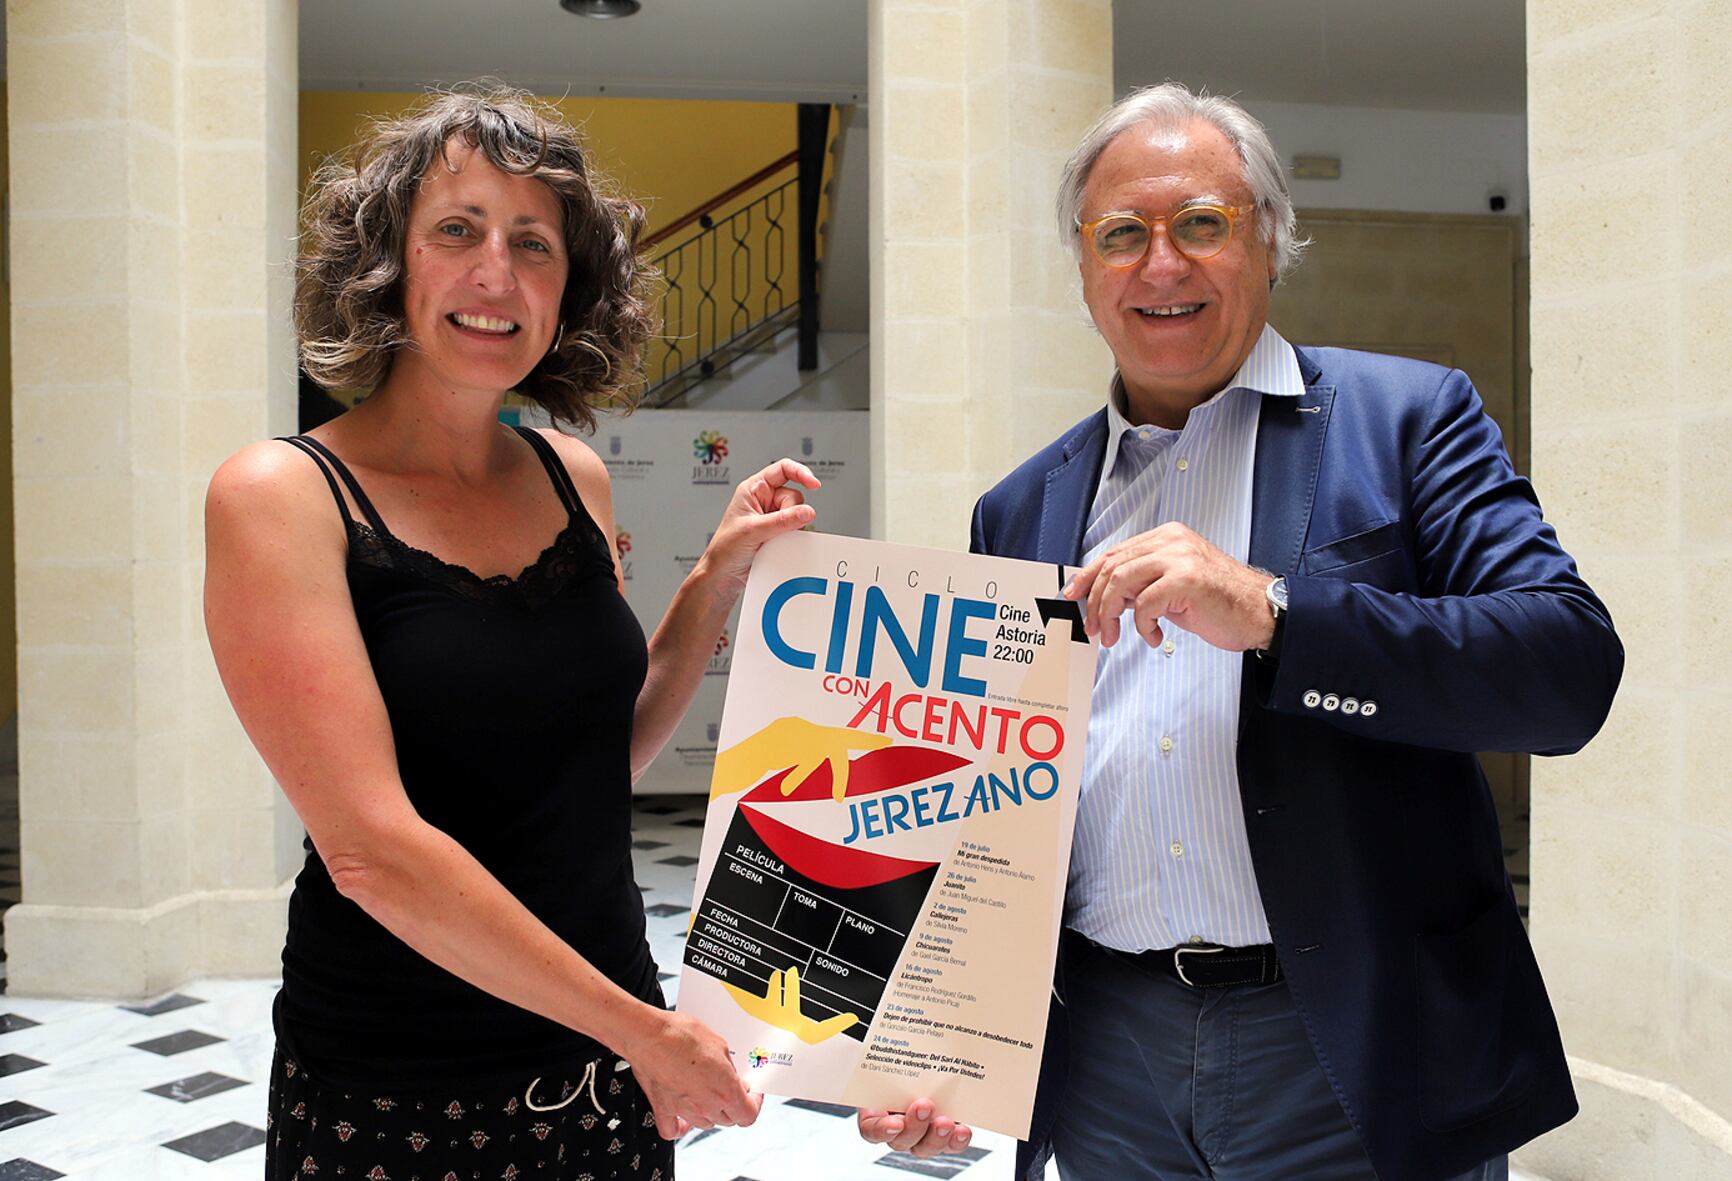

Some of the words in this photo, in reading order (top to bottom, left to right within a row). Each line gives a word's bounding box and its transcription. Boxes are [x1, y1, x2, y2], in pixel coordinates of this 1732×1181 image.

[692, 466, 730, 479] JEREZ
[836, 561, 998, 599] CICLO
[999, 604, 1031, 623] Cine
[761, 576, 998, 698] CINE
[995, 625, 1046, 646] Astoria
[993, 645, 1034, 664] 22:00
[823, 675, 870, 698] CON
[847, 682, 1065, 761] ACENTO
[843, 761, 1059, 844] JEREZANO
[969, 842, 977, 850] de
[977, 845, 991, 853] julio
[736, 844, 784, 875] PELÍCULA
[965, 852, 980, 860] gran
[980, 855, 1010, 866] despedida
[729, 862, 764, 885] ESCENA
[961, 860, 980, 870] Antonio
[981, 864, 994, 872] Hens
[999, 868, 1019, 877] Antonio
[944, 881, 966, 890] Juanito
[794, 891, 817, 910] TOMA
[947, 891, 961, 899] Juan
[961, 893, 978, 903] Miguel
[710, 908, 739, 928] FECHA
[930, 910, 958, 922] Callejeras
[947, 906, 967, 914] agosto
[845, 915, 875, 935] PLANO
[933, 921, 947, 930] Silvia
[947, 924, 968, 934] Moreno
[704, 923, 762, 956] PRODUCTORA
[915, 941, 950, 954] Chicuarotes
[933, 936, 953, 945] agosto
[698, 939, 746, 967] DIRECTORA
[919, 951, 931, 959] Gael
[949, 957, 967, 967] Bernal
[815, 956, 850, 977] SONIDO
[905, 963, 913, 971] 16
[922, 967, 943, 976] agosto
[904, 982, 930, 992] Francisco
[925, 995, 946, 1005] Antonio
[903, 1007, 924, 1015] agosto
[883, 1012, 900, 1021] Dejen
[909, 1017, 933, 1027] prohibir
[933, 1021, 945, 1029] que
[954, 1026, 978, 1036] alcanzo
[982, 1031, 1019, 1046] desobedecer
[1019, 1040, 1033, 1049] todo
[890, 1039, 910, 1047] agosto
[903, 1059, 931, 1070] videoclips
[930, 1053, 940, 1061] Del
